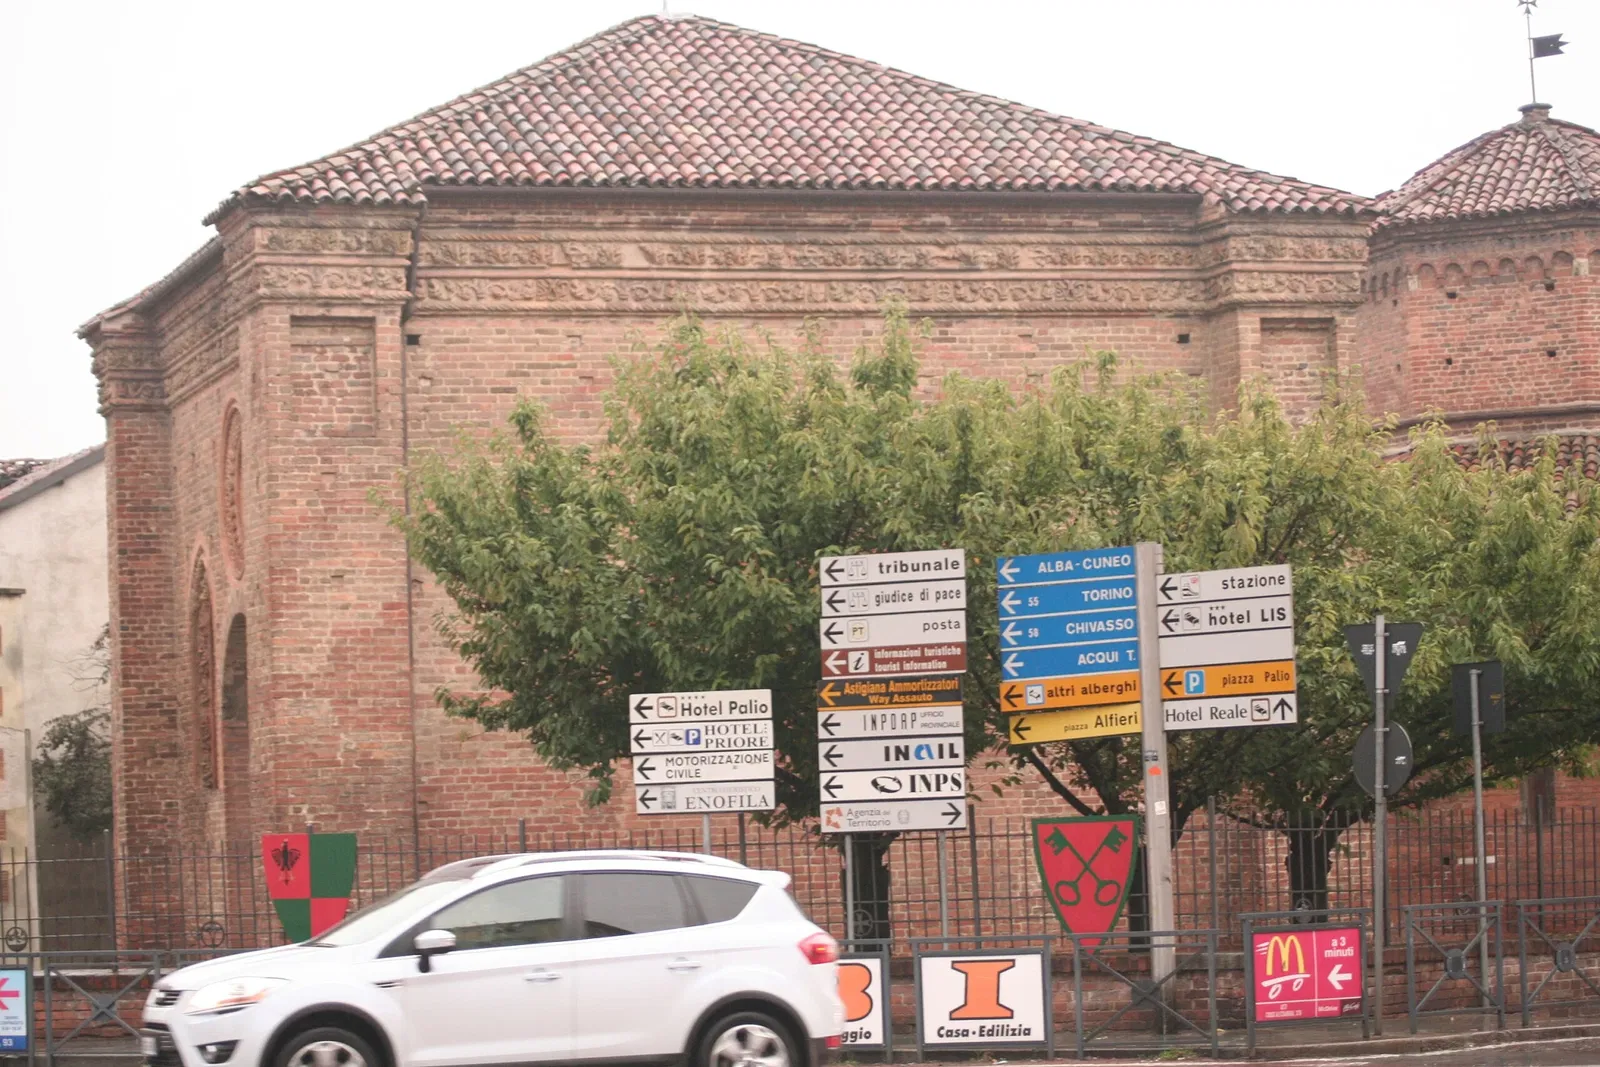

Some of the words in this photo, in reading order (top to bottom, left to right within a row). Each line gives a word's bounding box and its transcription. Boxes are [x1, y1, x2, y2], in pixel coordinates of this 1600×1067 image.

[878, 557, 960, 574] tribunale
[1221, 574, 1287, 590] stazione
[875, 590, 914, 607] giudice
[920, 588, 929, 601] di
[935, 589, 961, 602] pace
[1027, 596, 1040, 607] 55
[1081, 586, 1134, 602] TORINO
[1208, 610, 1251, 627] hotel
[1261, 607, 1287, 623] LIS
[852, 627, 864, 636] PT
[923, 619, 961, 632] posta
[1027, 628, 1040, 638] 58
[1065, 618, 1135, 635] CHIVASSO
[874, 647, 921, 659] informazioni
[924, 646, 961, 656] turistiche
[1077, 651, 1119, 666] ACQUI
[1125, 649, 1136, 662] T.
[875, 662, 900, 672] tourist
[903, 660, 947, 671] information
[844, 682, 886, 696] Astigiana
[888, 677, 959, 693] Ammortizzatori
[1188, 672, 1201, 693] P
[1222, 674, 1255, 689] piazza
[1264, 669, 1291, 683] Palio
[1047, 685, 1075, 699] altri
[1081, 679, 1137, 696] alberghi
[868, 695, 890, 704] Way
[892, 693, 933, 703] Assauto
[680, 700, 724, 717] Hotel
[728, 699, 769, 715] Palio
[1165, 706, 1203, 723] Hotel
[1210, 704, 1248, 720] Reale
[704, 723, 763, 736] HOTEL
[920, 721, 960, 729] PROVINCIALE
[1063, 723, 1089, 733] piazza
[1093, 711, 1139, 730] Alfieri
[688, 731, 698, 744] P
[704, 736, 770, 749] PRIORE
[665, 753, 770, 767] MOTORIZZAZIONE
[665, 768, 702, 779] CIVILE
[909, 772, 962, 793] INPS
[684, 794, 770, 810] ENOFILA
[846, 808, 881, 818] Agenzia
[846, 814, 892, 828] Territorio
[1340, 936, 1347, 946] 3
[1324, 946, 1354, 958] minuti
[841, 1027, 872, 1043] ggio
